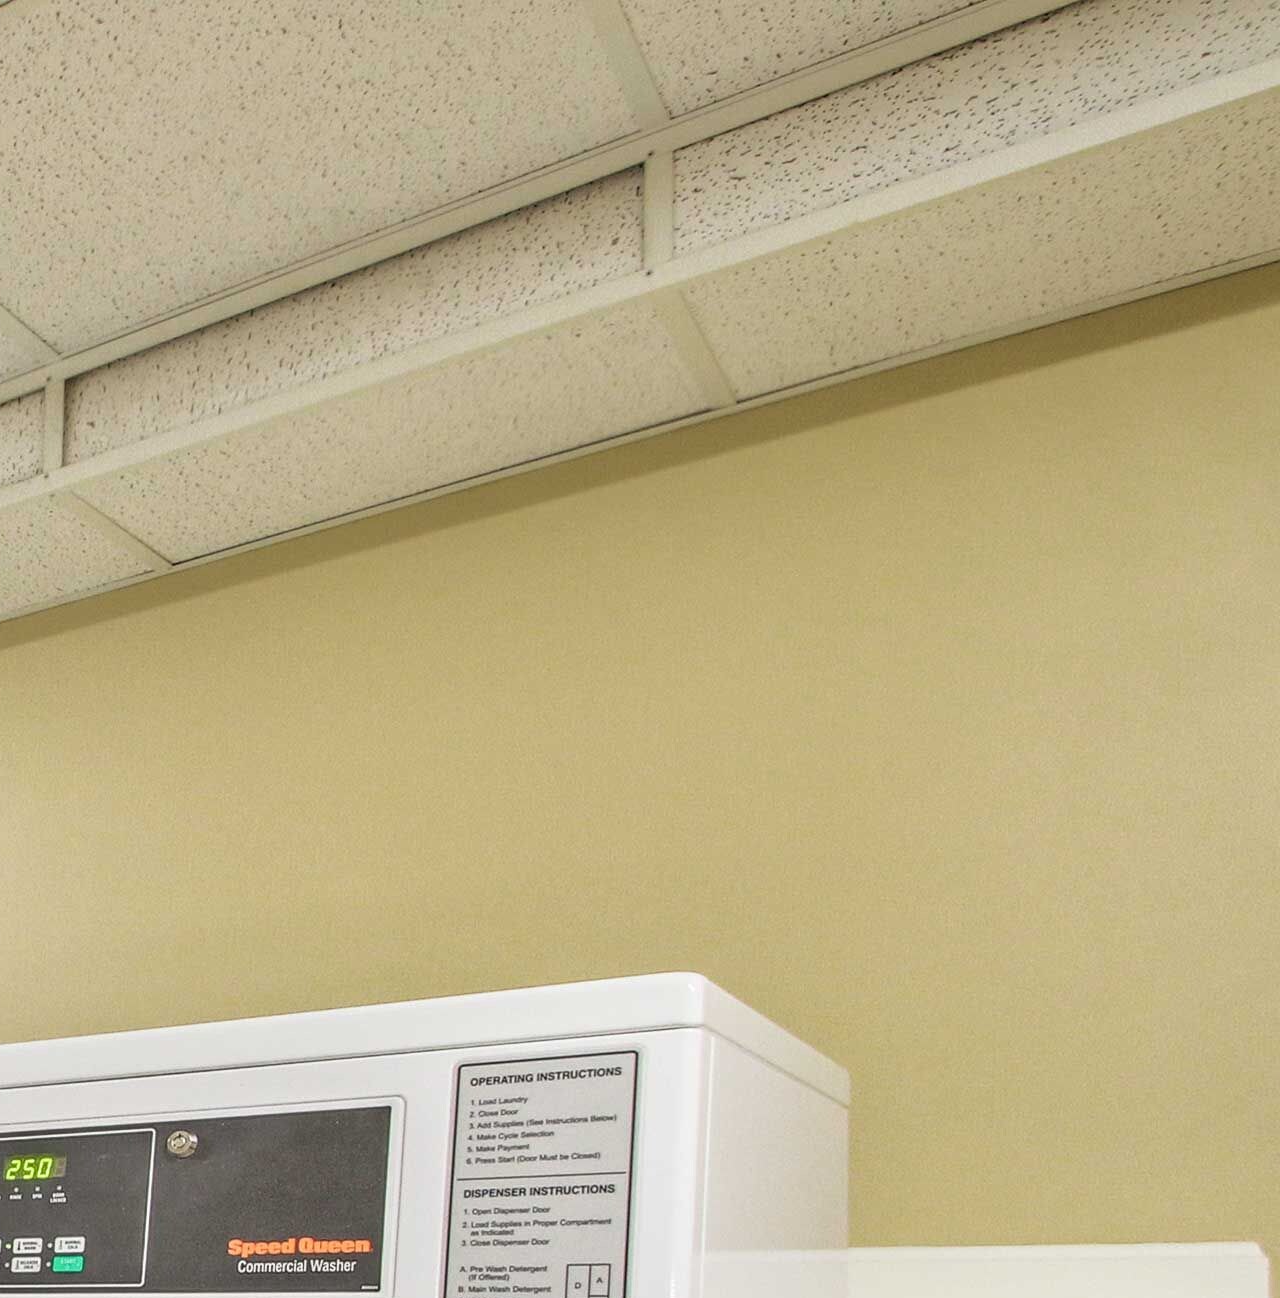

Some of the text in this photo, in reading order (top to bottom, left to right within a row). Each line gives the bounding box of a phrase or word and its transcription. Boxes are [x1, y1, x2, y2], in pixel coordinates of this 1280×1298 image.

[470, 1067, 622, 1087] OPERATING INSTRUCTIONS
[498, 1097, 528, 1105] Laundry
[478, 1110, 498, 1118] Close
[493, 1120, 524, 1128] Supplies
[526, 1118, 544, 1127] (See
[546, 1116, 588, 1125] Instructions
[590, 1114, 617, 1122] Below)
[477, 1133, 496, 1141] Make
[498, 1132, 518, 1140] Cycle
[520, 1130, 555, 1138] Selection
[497, 1143, 530, 1152] Payment
[517, 1154, 538, 1163] (Door
[571, 1152, 601, 1160] Closed)
[5, 1157, 53, 1181] 250
[464, 1184, 615, 1199] DISPENSER INSTRUCTIONS
[472, 1208, 491, 1216] Open
[493, 1207, 530, 1215] Dispenser
[491, 1220, 522, 1228] Supplies
[533, 1220, 557, 1228] Proper
[560, 1218, 611, 1227] Compartment
[228, 1237, 371, 1258] Speed Queen
[492, 1239, 529, 1247] Dispenser
[238, 1260, 357, 1273] Commercial Washer
[470, 1265, 484, 1273] Pre
[486, 1265, 507, 1273] Wash
[509, 1265, 547, 1274] Detergent
[513, 1286, 551, 1294] Detergent
